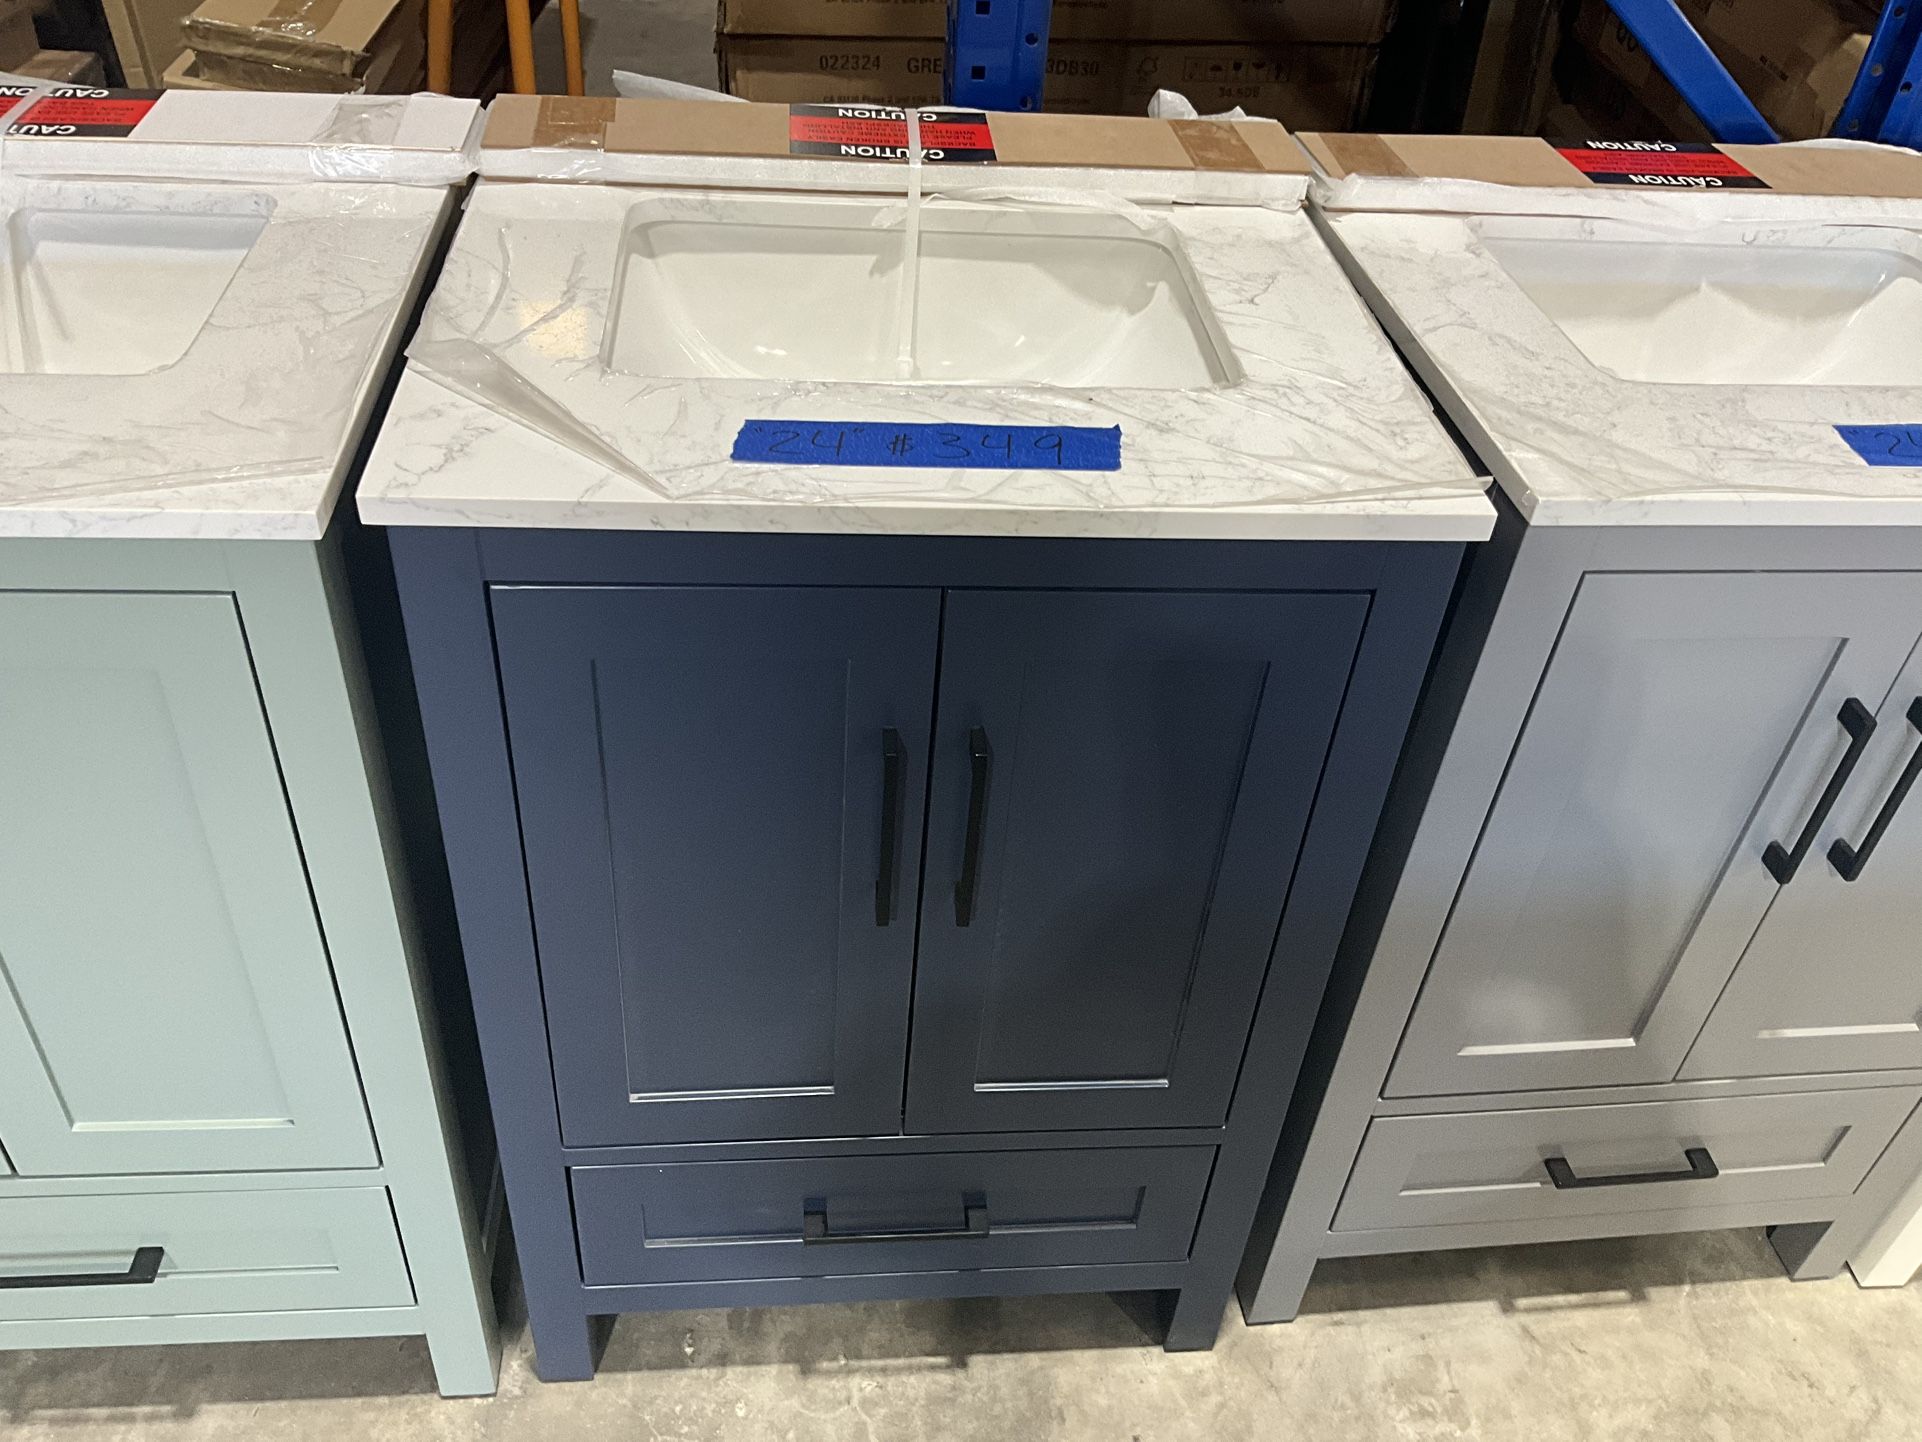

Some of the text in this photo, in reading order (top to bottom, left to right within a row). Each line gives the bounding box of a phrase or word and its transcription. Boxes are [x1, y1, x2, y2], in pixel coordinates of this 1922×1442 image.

[819, 55, 880, 71] 022324
[0, 87, 109, 98] CAUON
[1586, 140, 1677, 151] CAUTION
[1628, 174, 1723, 187] CAUTION
